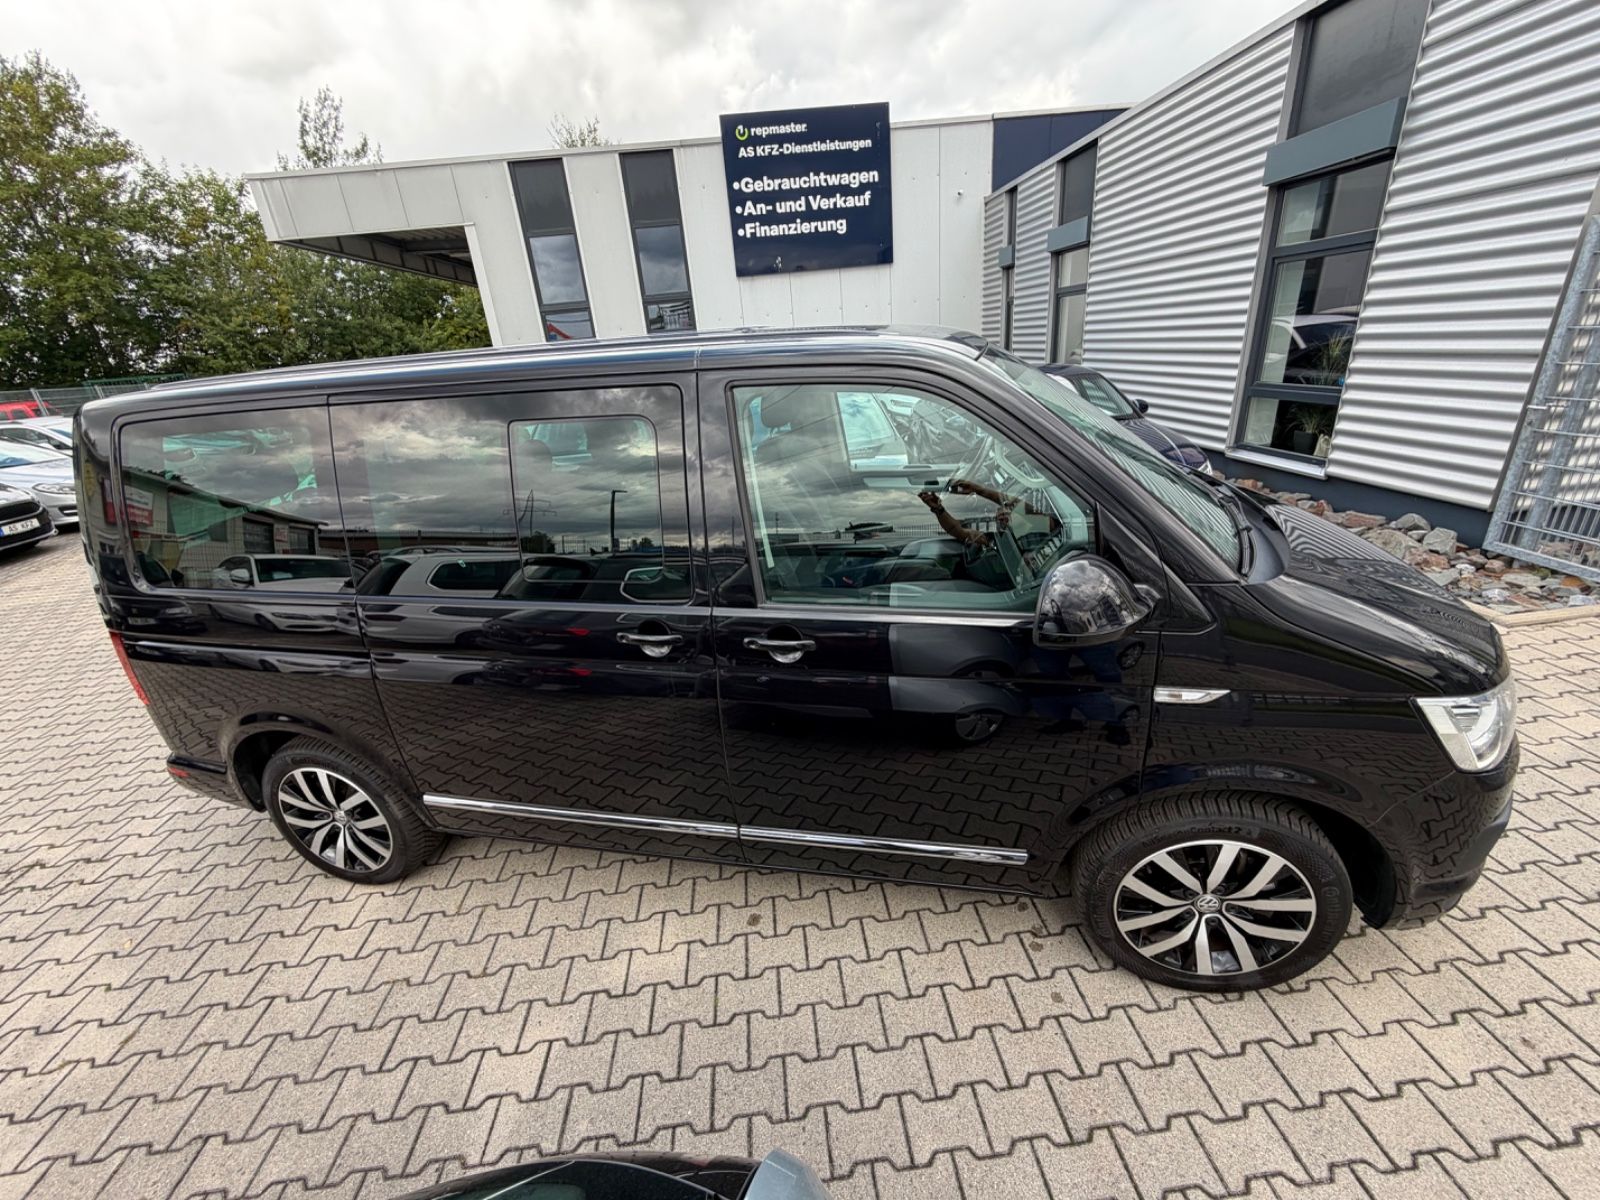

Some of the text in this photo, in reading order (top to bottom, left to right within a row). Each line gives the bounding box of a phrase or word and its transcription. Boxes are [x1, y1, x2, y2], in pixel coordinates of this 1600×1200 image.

[738, 139, 872, 158] AS KFZ-Dienstleistungen
[741, 170, 879, 192] Gebrauchtwagen
[743, 190, 871, 216] An- und Verkauf
[745, 218, 847, 238] Finanzierung
